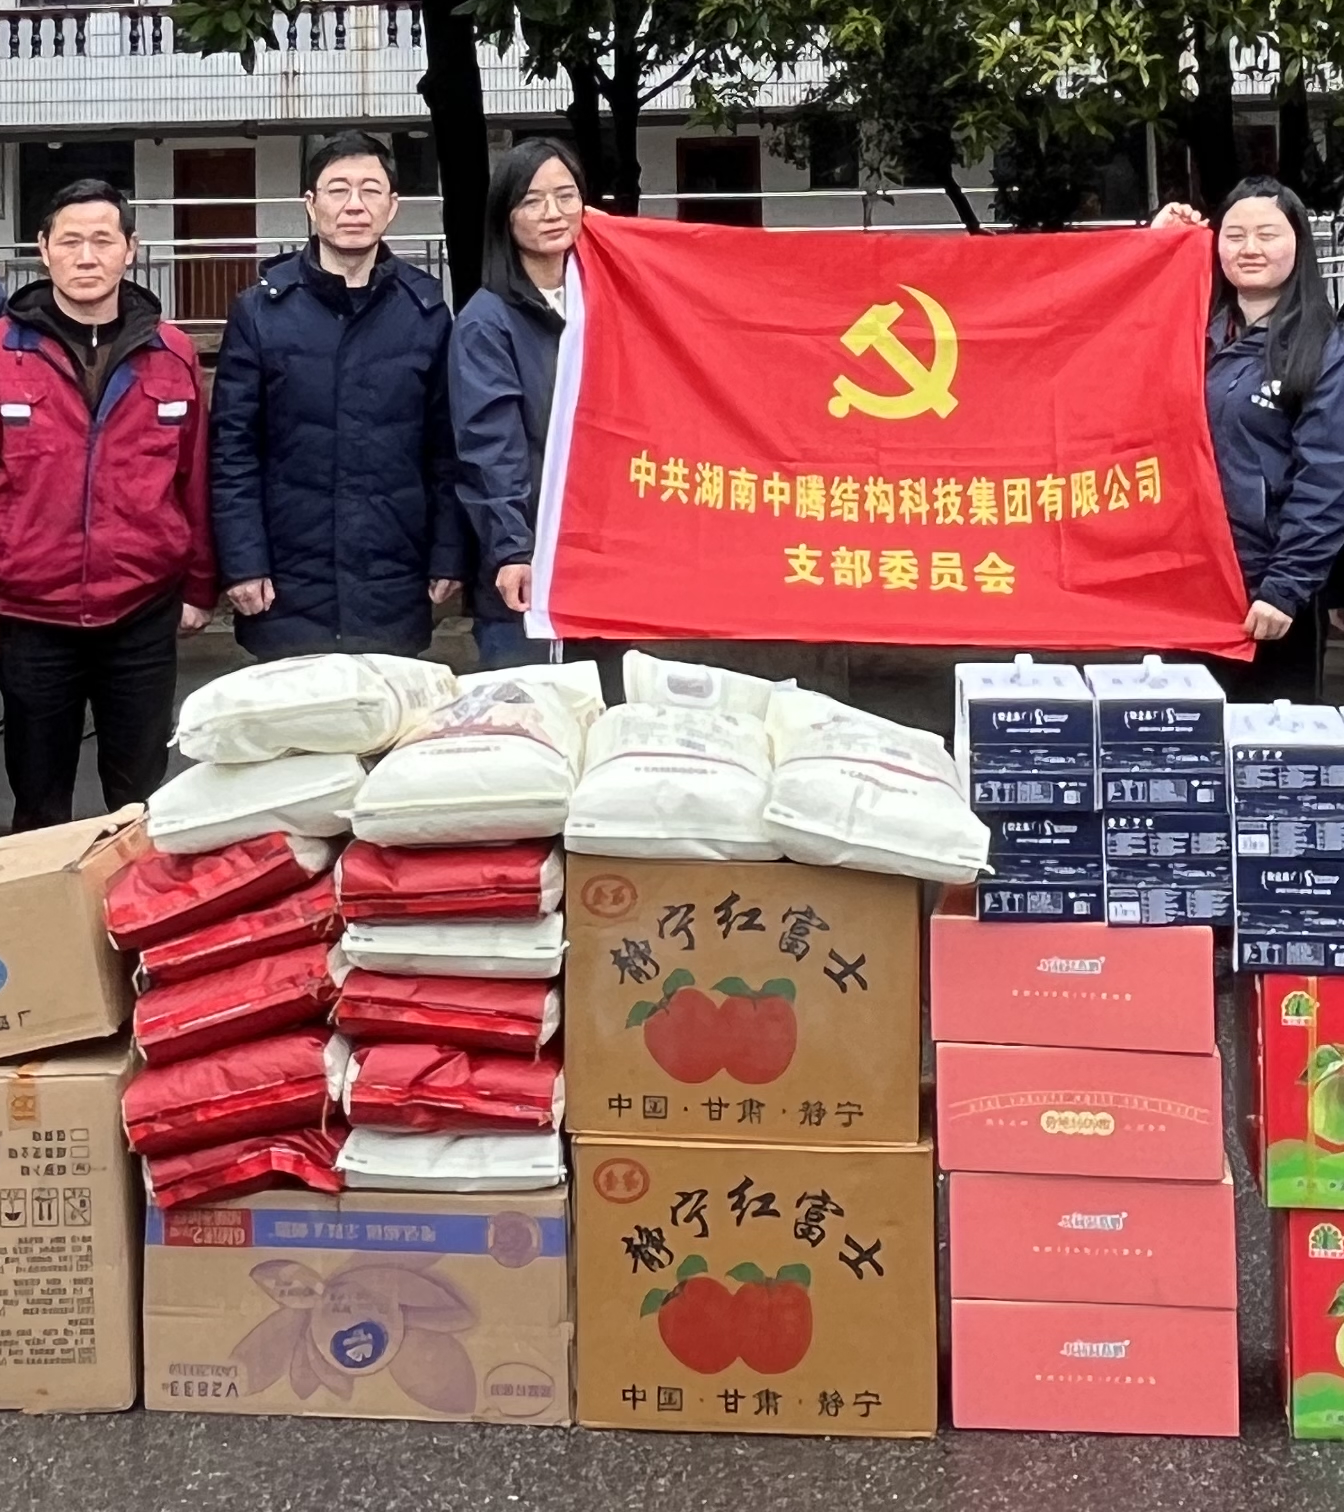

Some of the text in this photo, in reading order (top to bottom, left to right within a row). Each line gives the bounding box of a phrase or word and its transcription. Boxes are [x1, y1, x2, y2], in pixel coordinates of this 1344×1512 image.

[629, 449, 1162, 526] 中共湖南中腾结构科技集团有限公司
[783, 543, 1016, 595] 支部委员会
